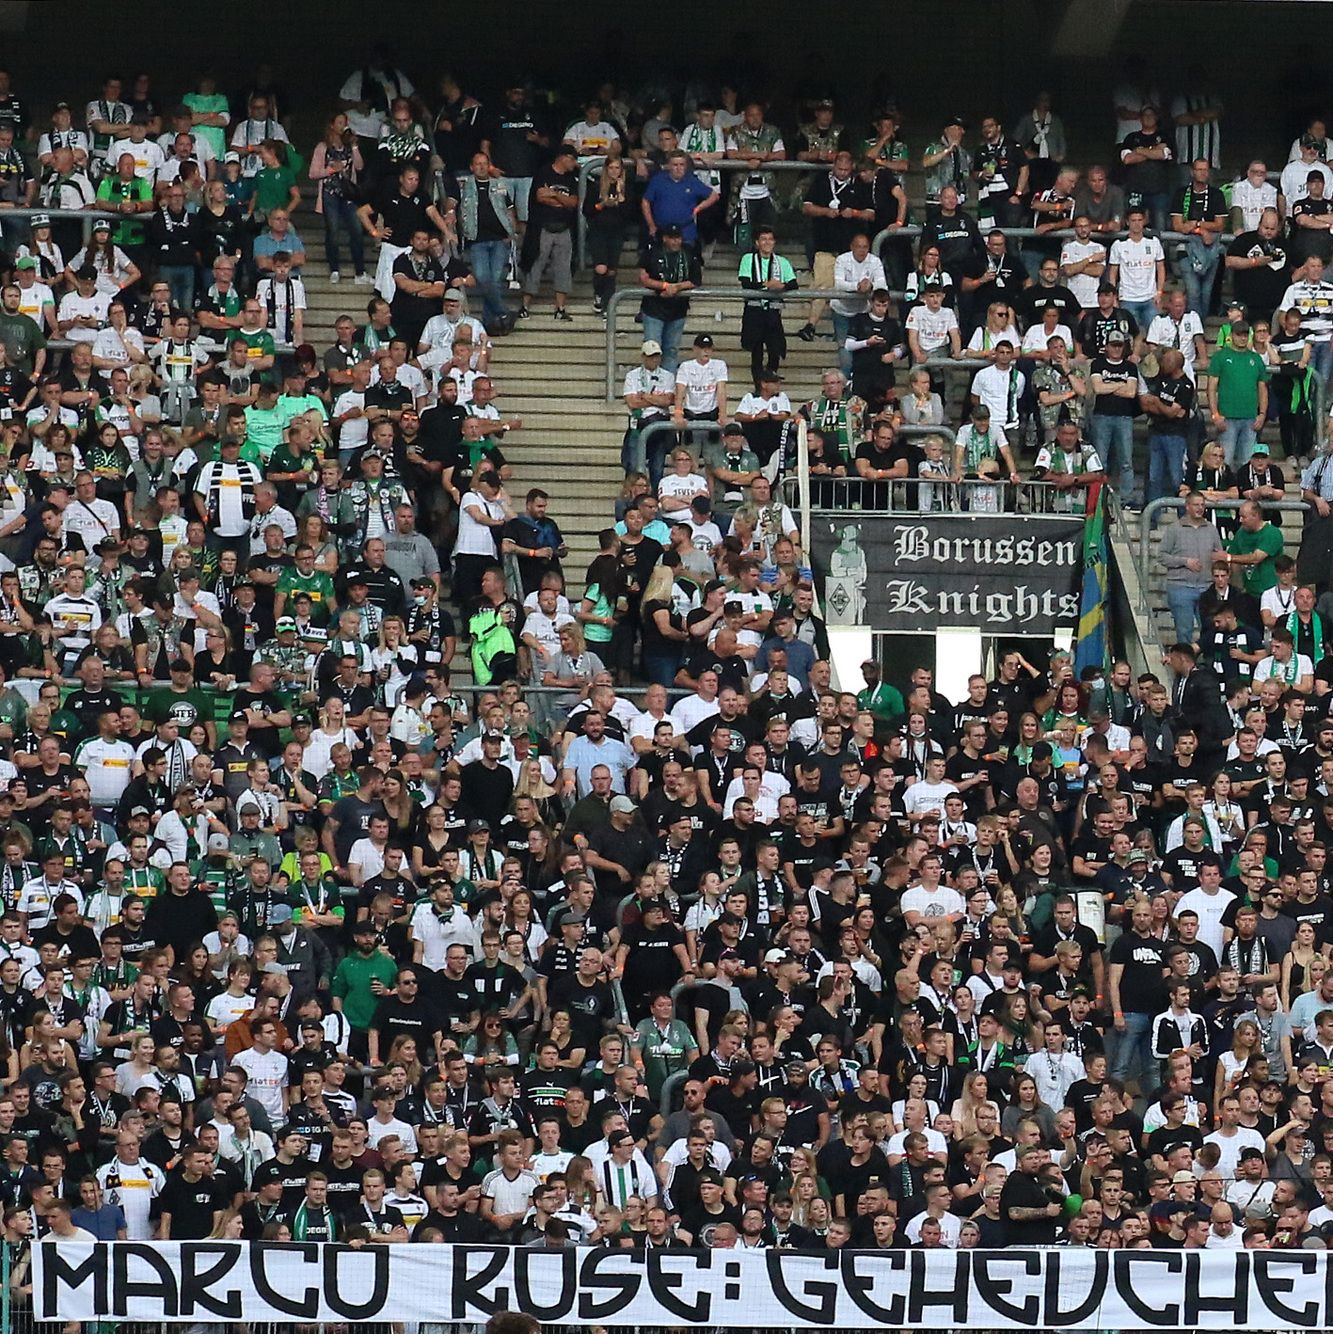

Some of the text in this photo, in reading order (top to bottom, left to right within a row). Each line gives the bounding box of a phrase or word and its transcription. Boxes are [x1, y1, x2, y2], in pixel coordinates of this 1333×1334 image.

[893, 524, 1077, 567] Borussen
[886, 579, 1080, 622] Knights
[41, 1242, 390, 1320] MARCO
[452, 1246, 742, 1322] ROSE:
